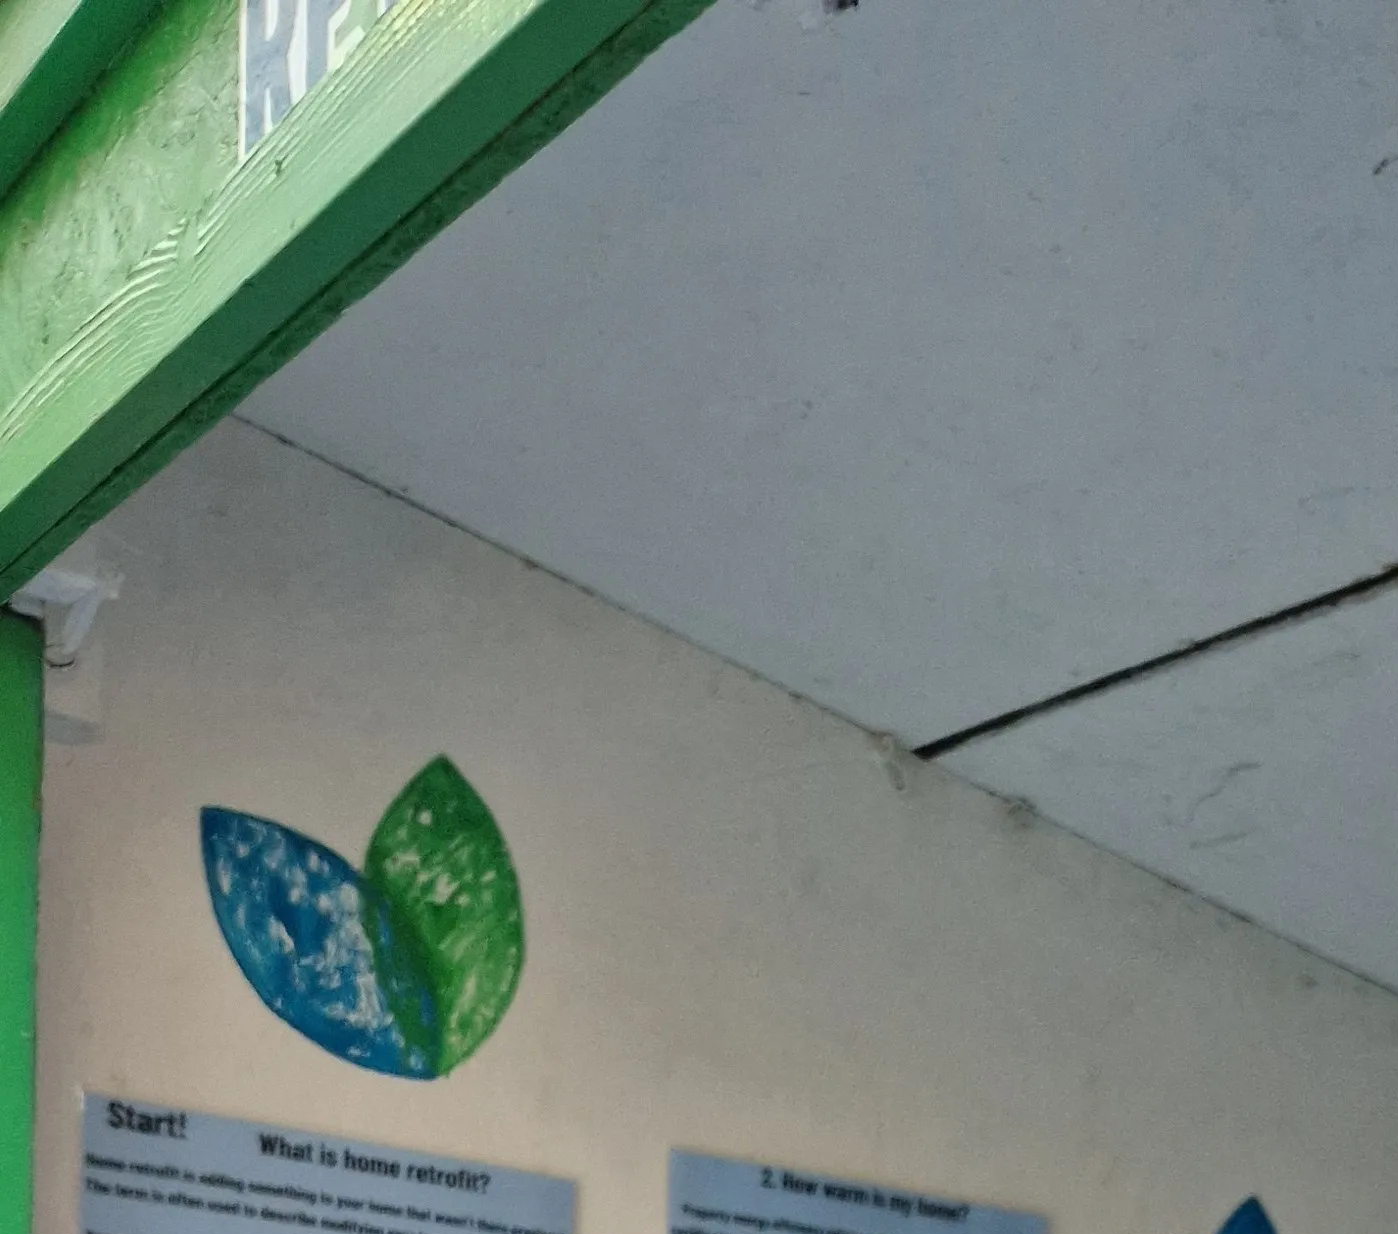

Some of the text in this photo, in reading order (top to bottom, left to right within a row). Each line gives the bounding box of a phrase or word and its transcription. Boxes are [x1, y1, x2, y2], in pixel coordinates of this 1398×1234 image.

[107, 1099, 187, 1140] Start!
[258, 1131, 491, 1195] What is home retrofit?
[781, 1173, 818, 1196] How
[822, 1182, 866, 1205] warm
[888, 1194, 911, 1218] my
